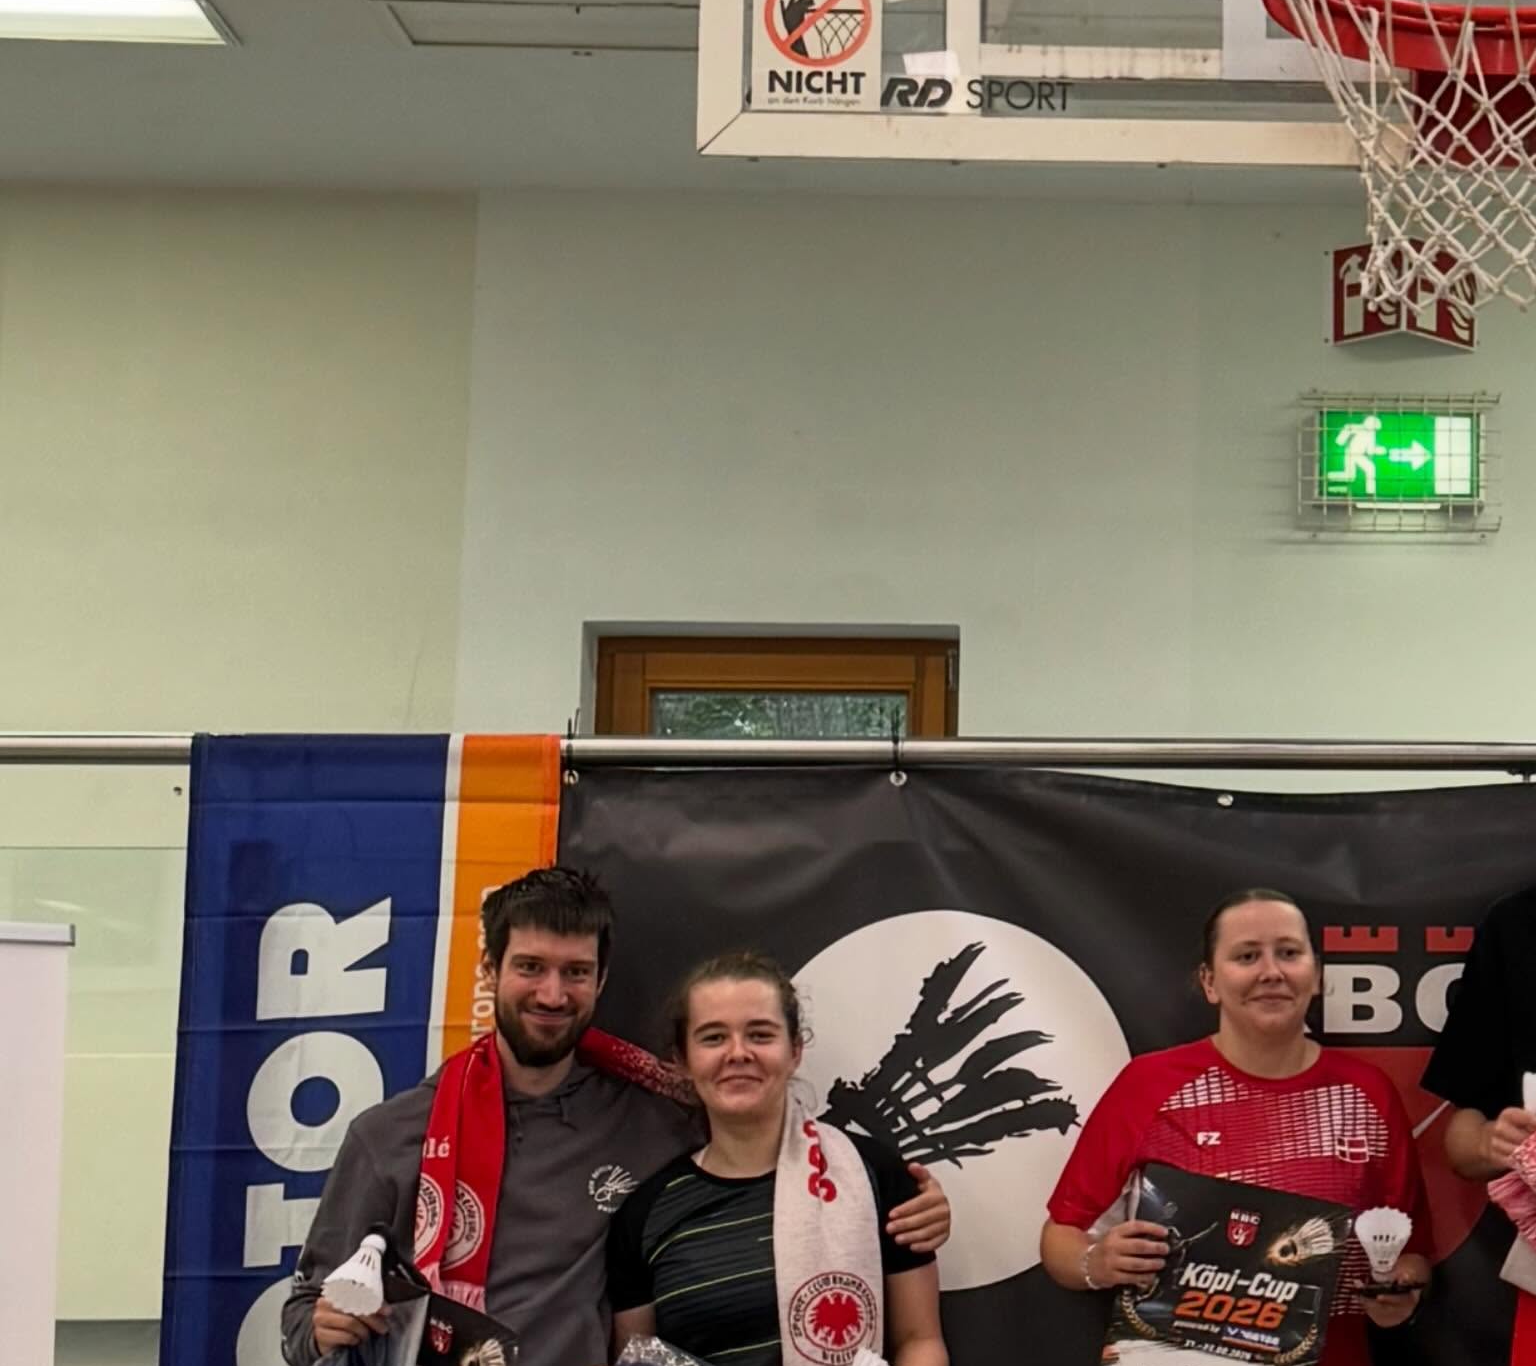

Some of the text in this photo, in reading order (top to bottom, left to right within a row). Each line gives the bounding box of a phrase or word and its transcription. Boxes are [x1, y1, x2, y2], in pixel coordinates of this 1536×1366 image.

[768, 70, 866, 94] NICHT
[880, 77, 1074, 111] RD SPORT
[1304, 963, 1466, 1033] BC
[423, 1136, 450, 1159] lé
[1197, 1131, 1221, 1145] FZ
[1179, 1261, 1299, 1303] Köpi-Cup
[1173, 1291, 1288, 1331] 2026
